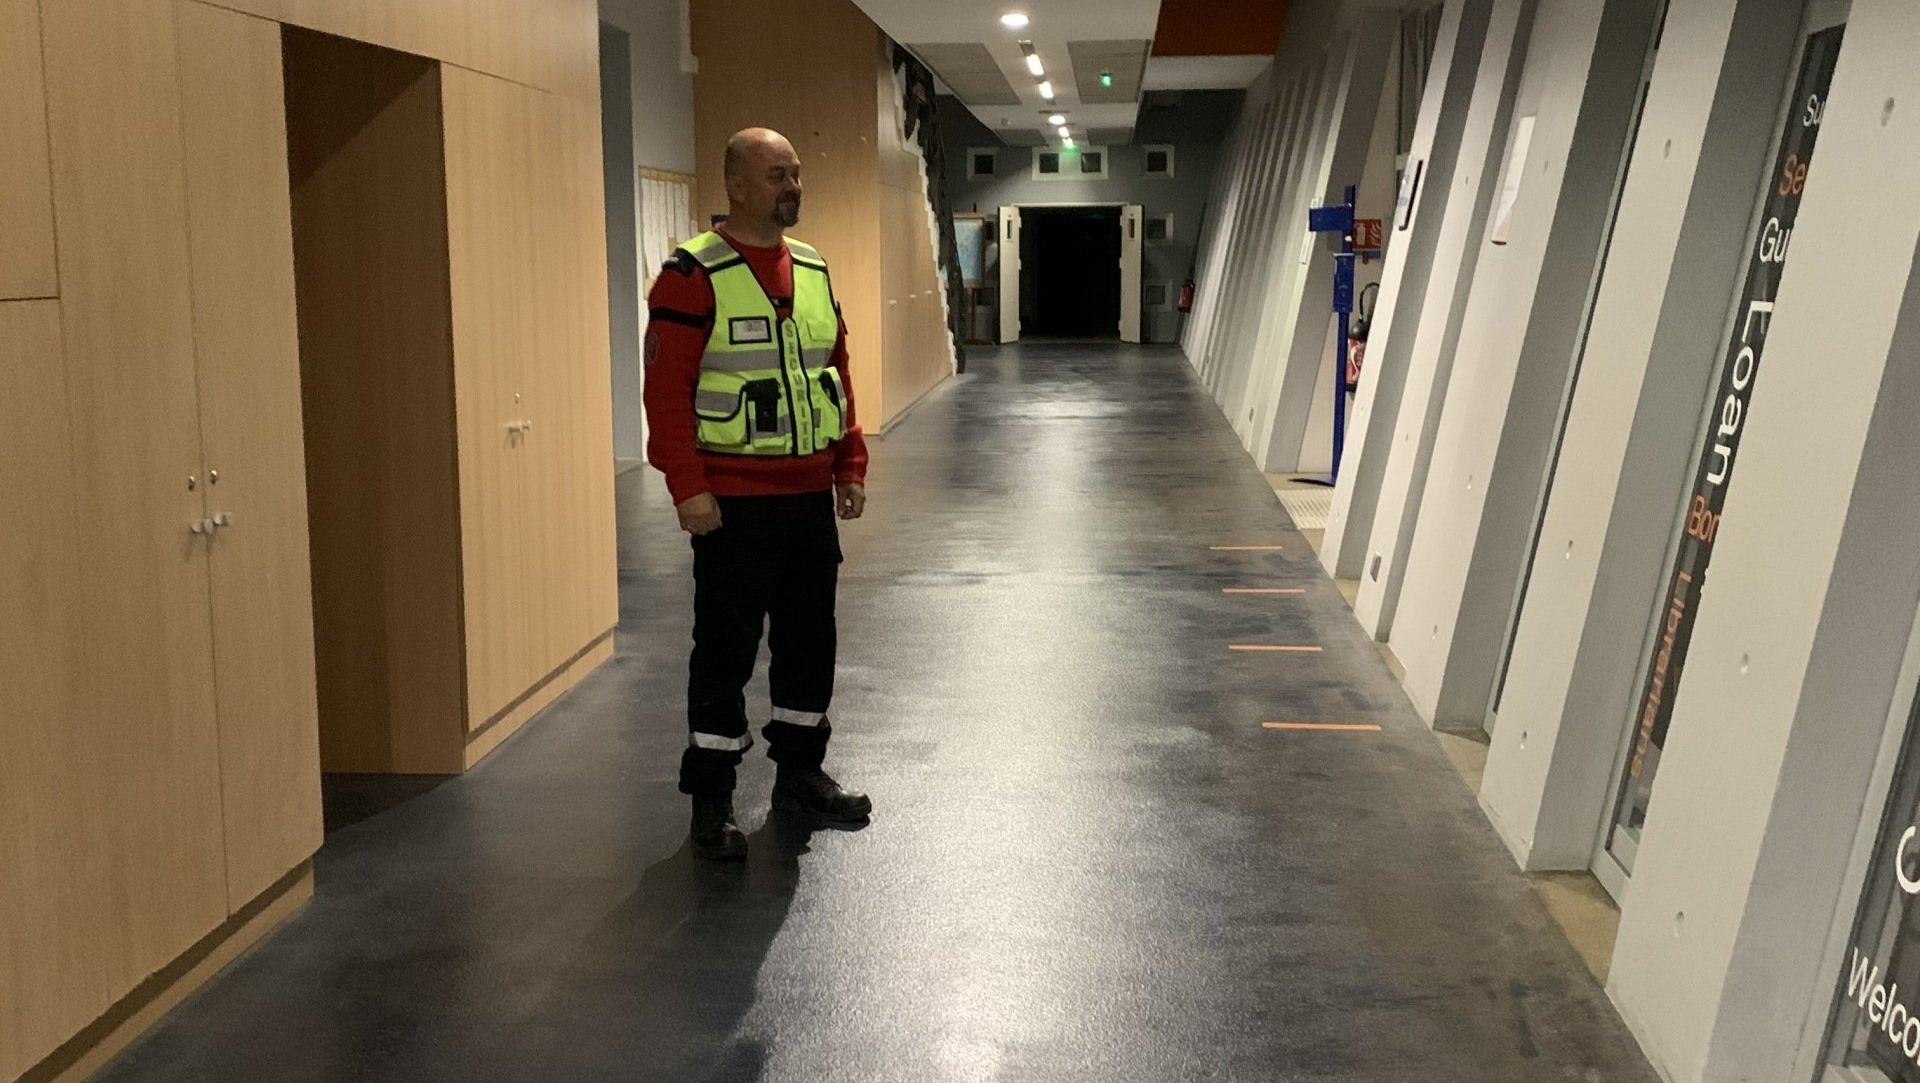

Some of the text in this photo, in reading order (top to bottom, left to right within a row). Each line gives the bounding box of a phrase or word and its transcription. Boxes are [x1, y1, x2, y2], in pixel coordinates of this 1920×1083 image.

[1759, 217, 1790, 263] Gu
[1706, 301, 1774, 485] Loan
[1848, 946, 1920, 1067] Welco
